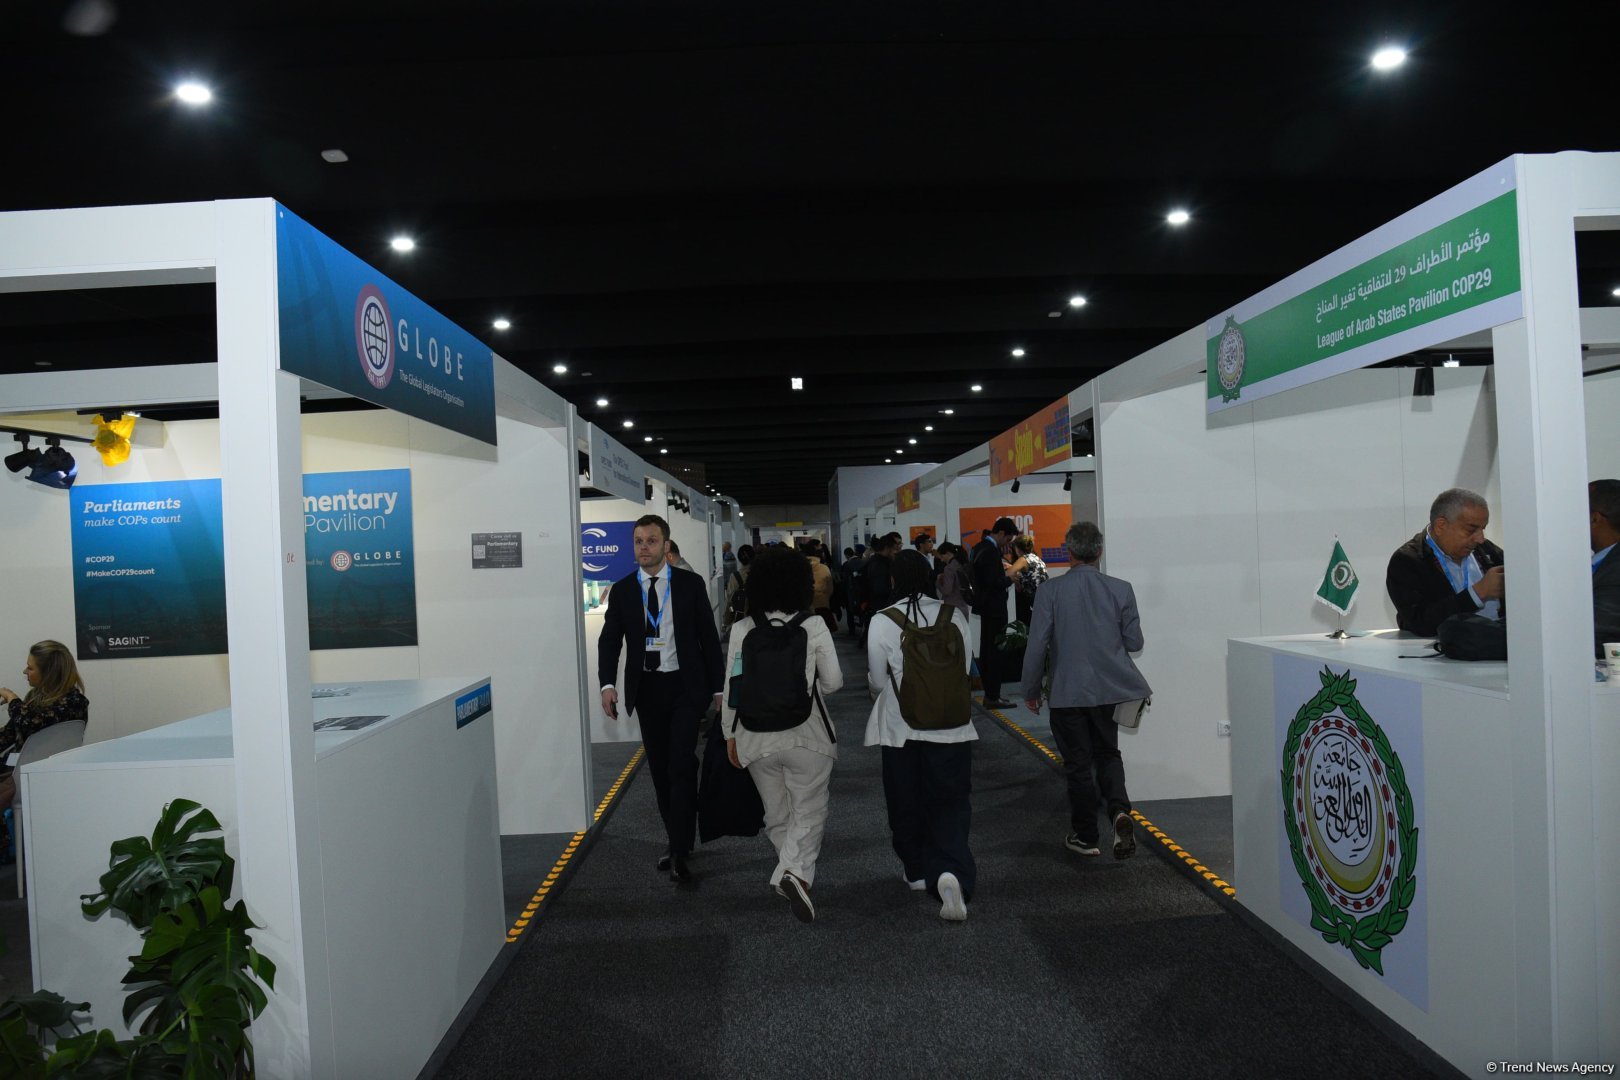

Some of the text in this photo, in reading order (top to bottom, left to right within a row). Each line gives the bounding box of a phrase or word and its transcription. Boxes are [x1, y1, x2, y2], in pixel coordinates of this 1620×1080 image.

[1316, 227, 1490, 323] مؤتمر الأطراف 29 لاتفاقية تغير المناخ
[1317, 267, 1492, 349] League of Arab States Pavilion COP29
[398, 318, 464, 381] GLOBE
[399, 369, 408, 383] The
[83, 498, 181, 514] Parliaments
[84, 514, 181, 527] make COPs count
[304, 512, 386, 533] Pavilion
[354, 551, 401, 560] GLOBE
[595, 544, 619, 553] FUND
[86, 555, 115, 564] #COP29
[86, 567, 156, 578] #MakeCOP29count
